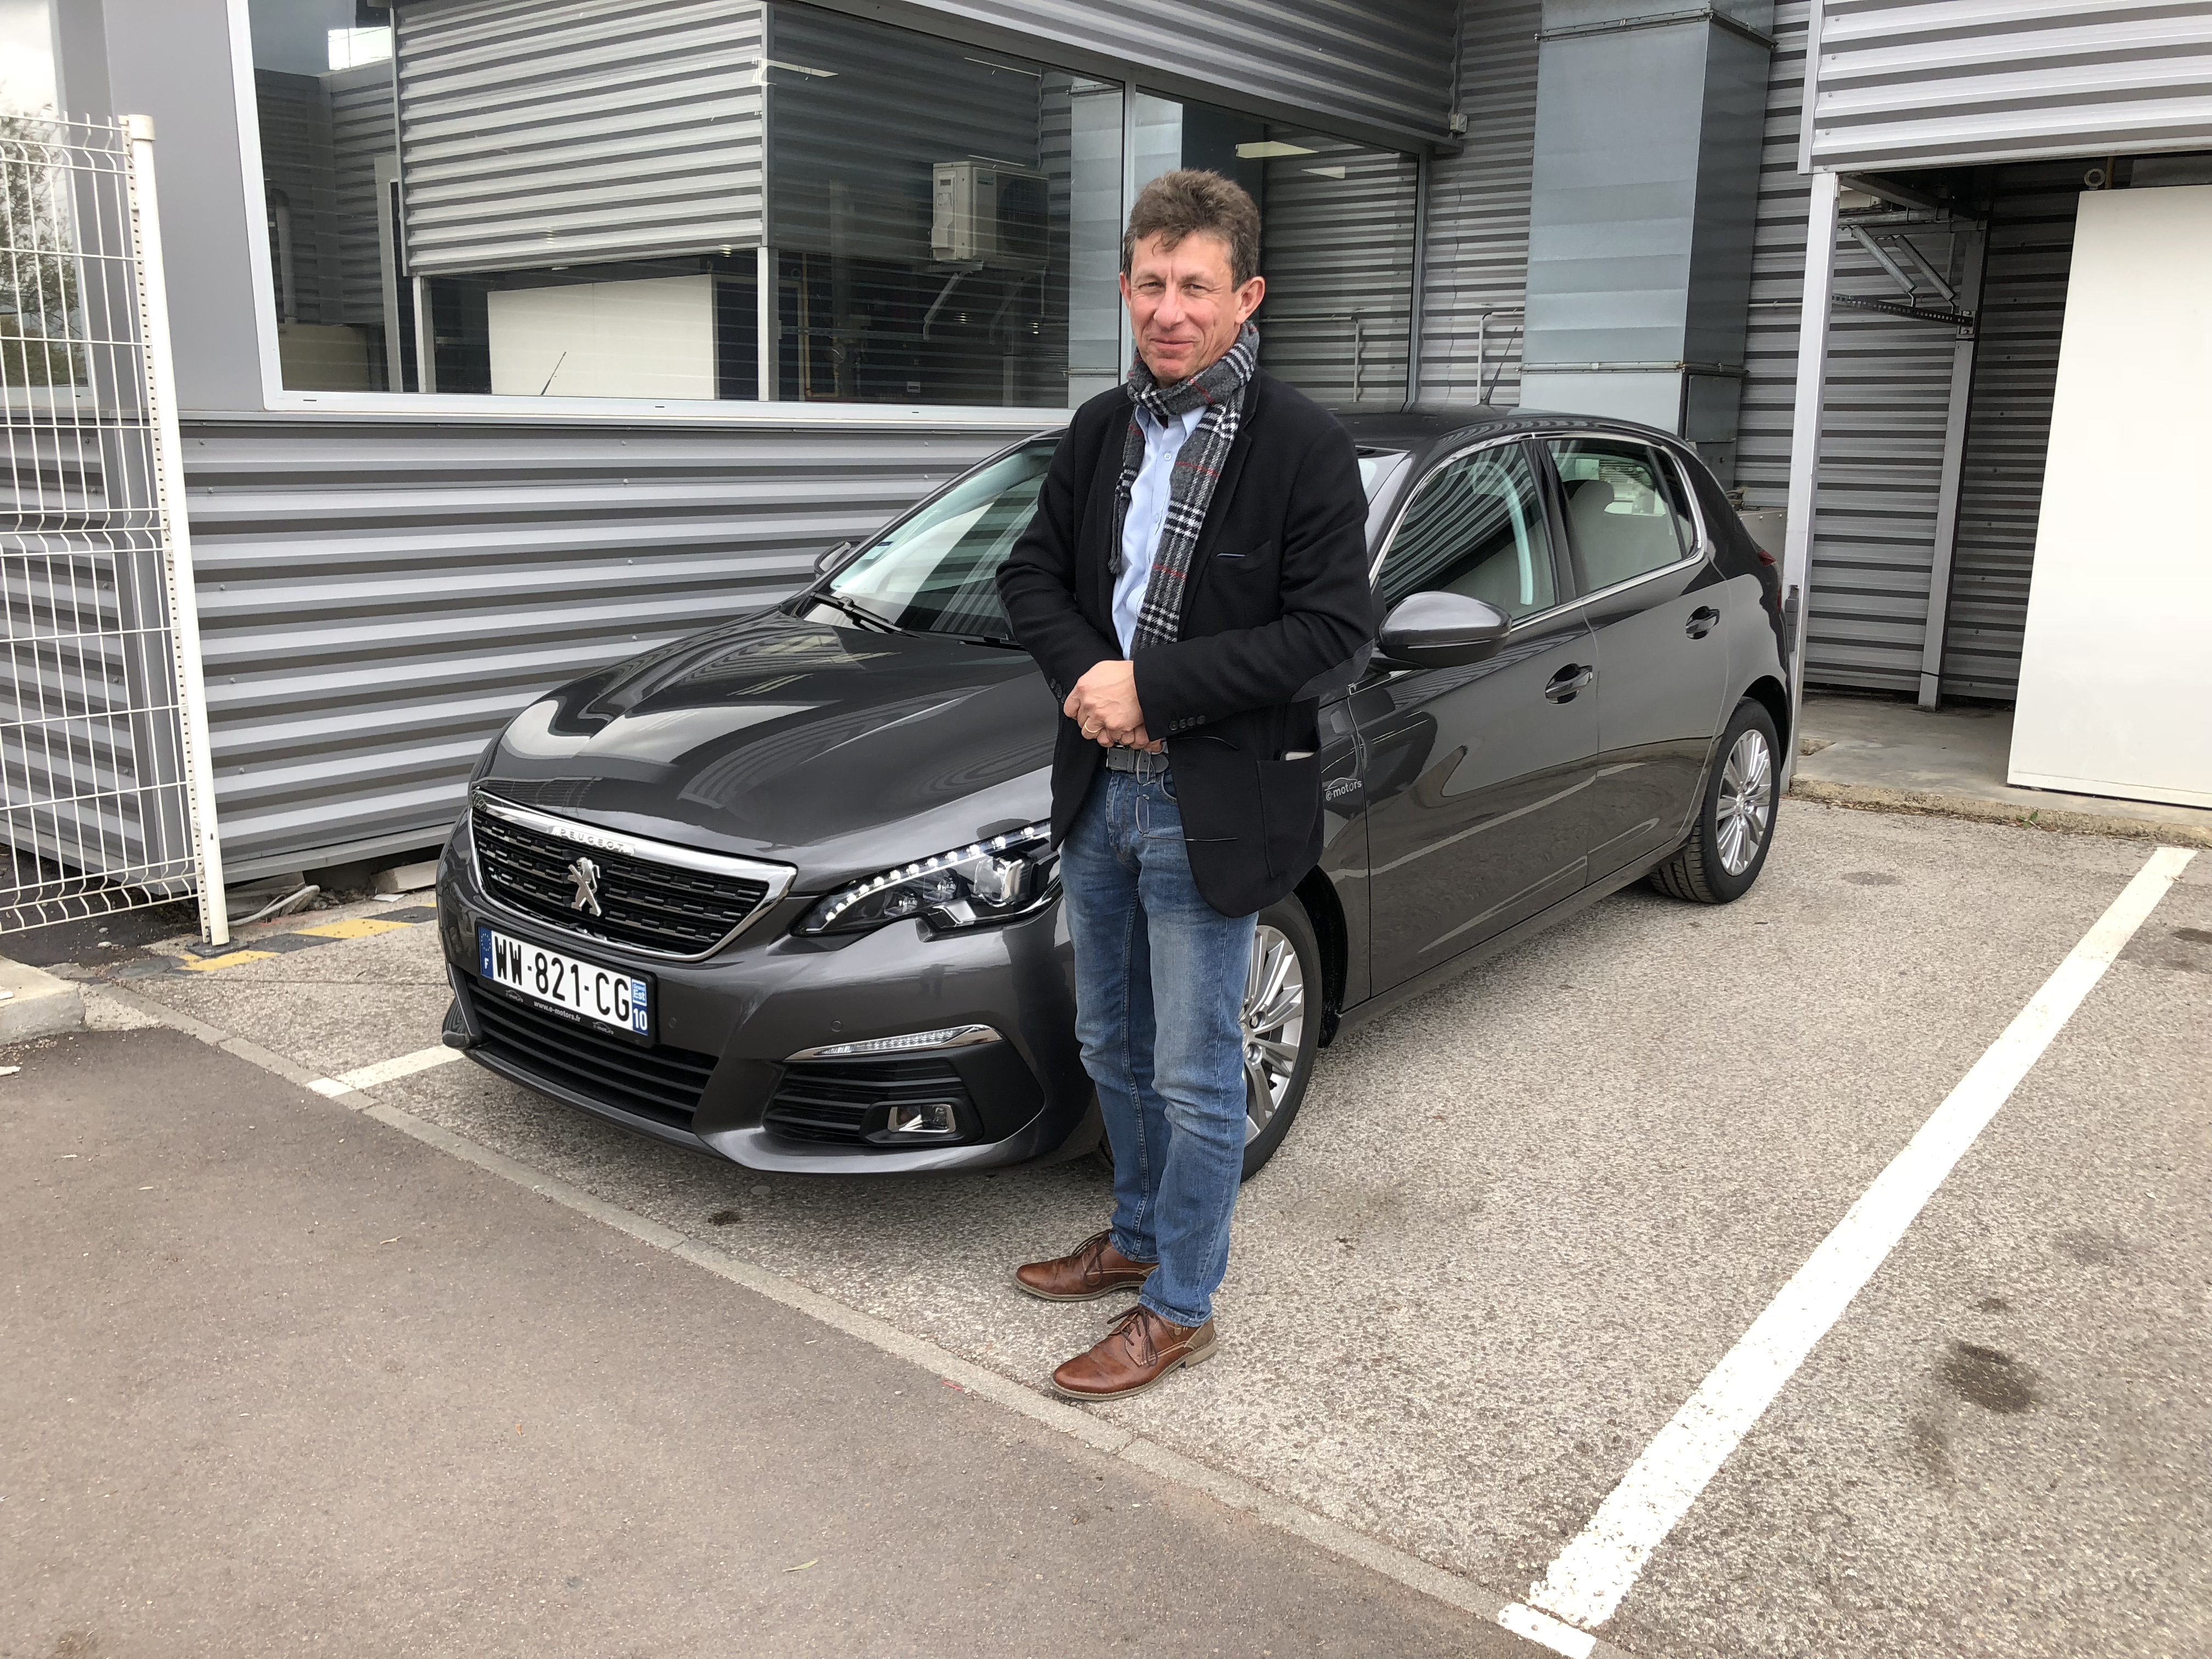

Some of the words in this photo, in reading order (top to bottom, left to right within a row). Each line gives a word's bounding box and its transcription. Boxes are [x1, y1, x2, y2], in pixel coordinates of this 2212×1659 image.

[560, 828, 624, 852] PEUGEOT
[484, 957, 489, 969] F
[494, 935, 630, 1022] WW-821-CG
[634, 989, 645, 1001] Est
[533, 1001, 581, 1023] www.e-motors.fr
[633, 1008, 648, 1031] 10
